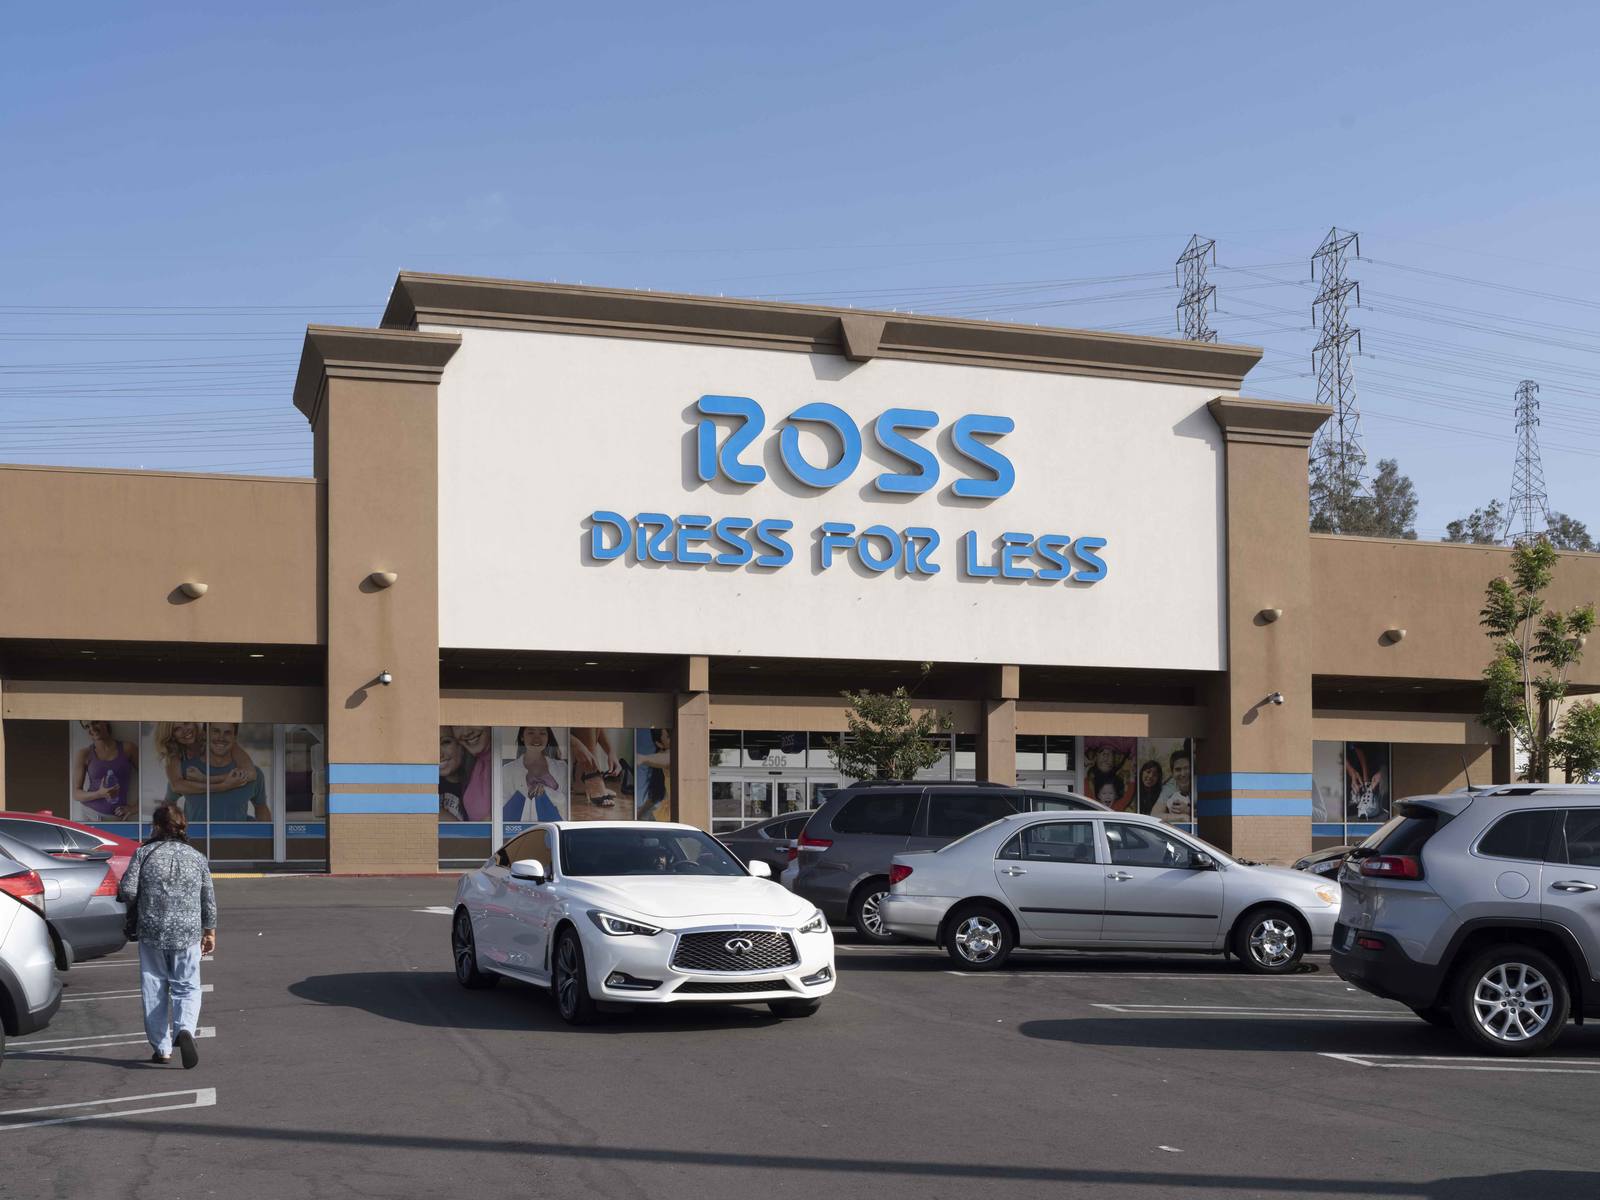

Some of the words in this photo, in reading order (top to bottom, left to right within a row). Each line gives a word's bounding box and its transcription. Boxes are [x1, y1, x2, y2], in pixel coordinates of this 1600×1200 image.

[696, 394, 1016, 499] ROSS
[591, 510, 794, 567] DRESS
[821, 521, 941, 574] FOR
[965, 529, 1108, 582] LESS
[761, 755, 787, 767] 2505
